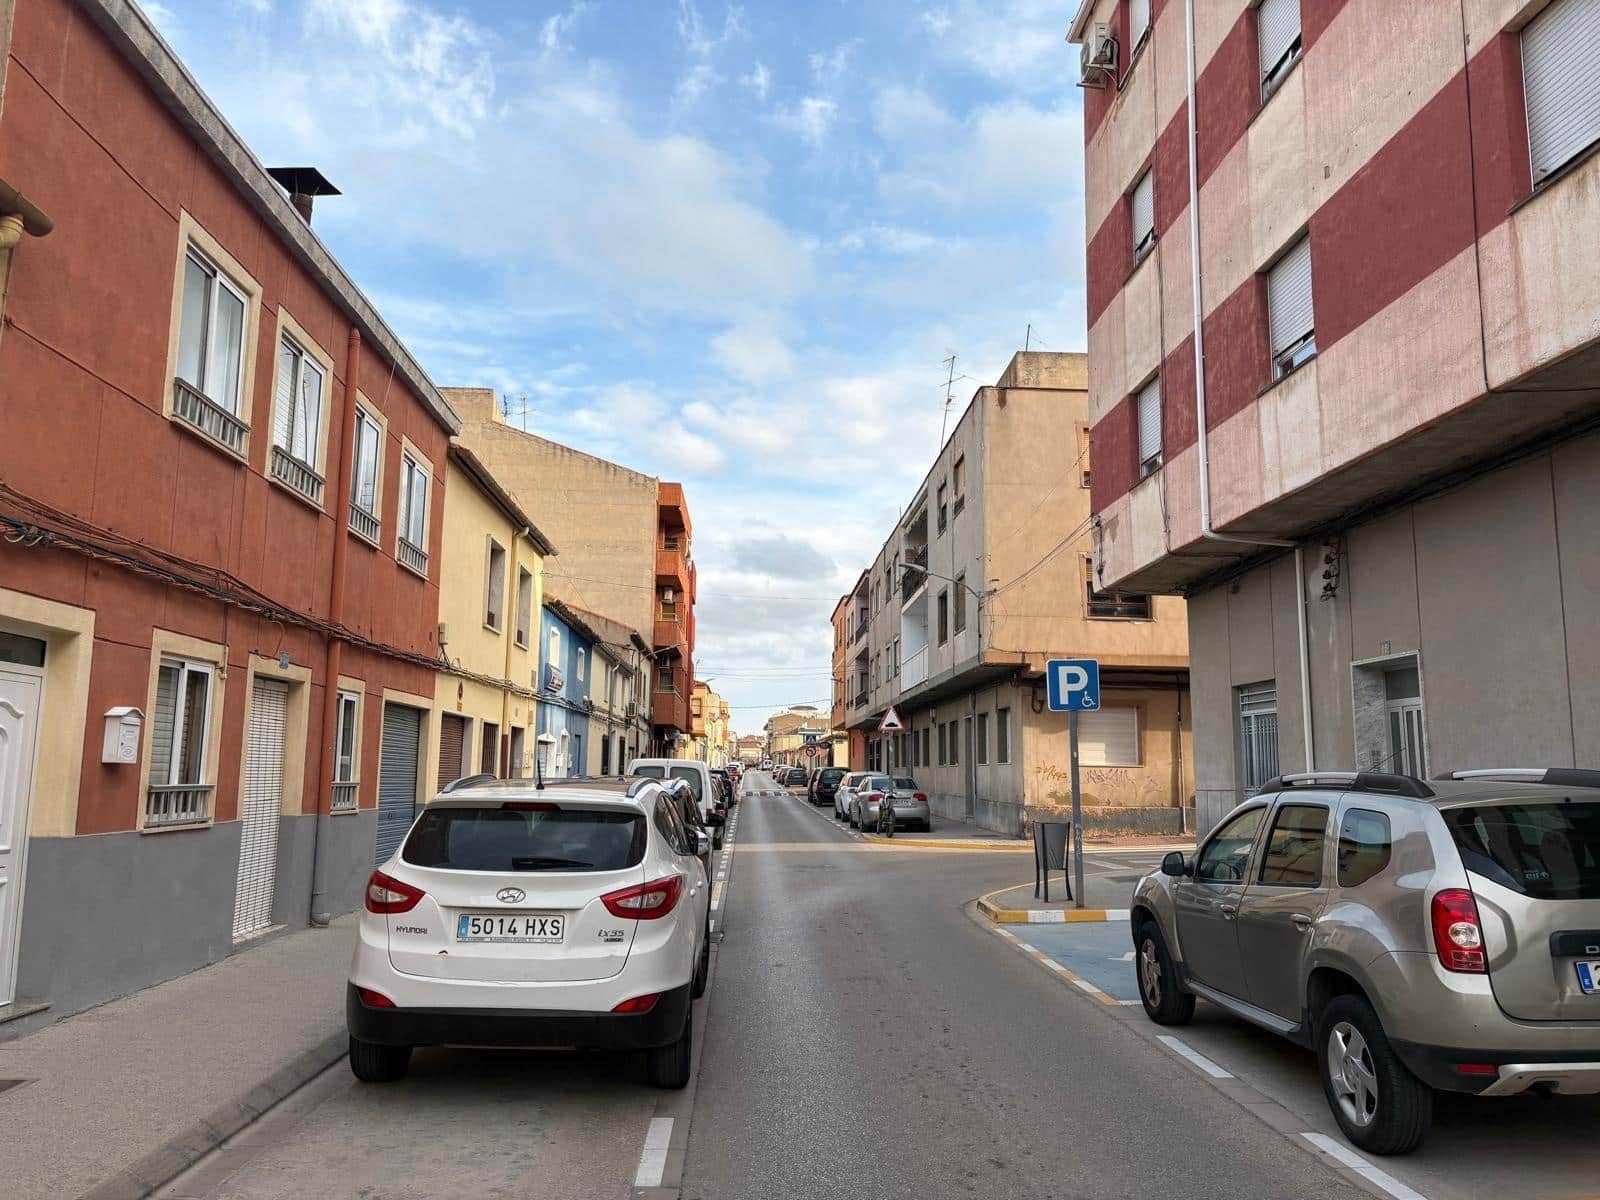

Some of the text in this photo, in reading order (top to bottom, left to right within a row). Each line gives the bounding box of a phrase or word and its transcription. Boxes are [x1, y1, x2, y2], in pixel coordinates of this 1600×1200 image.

[1058, 665, 1089, 705] P
[396, 926, 428, 935] HYUNDAI
[471, 918, 561, 936] 5014 HXS
